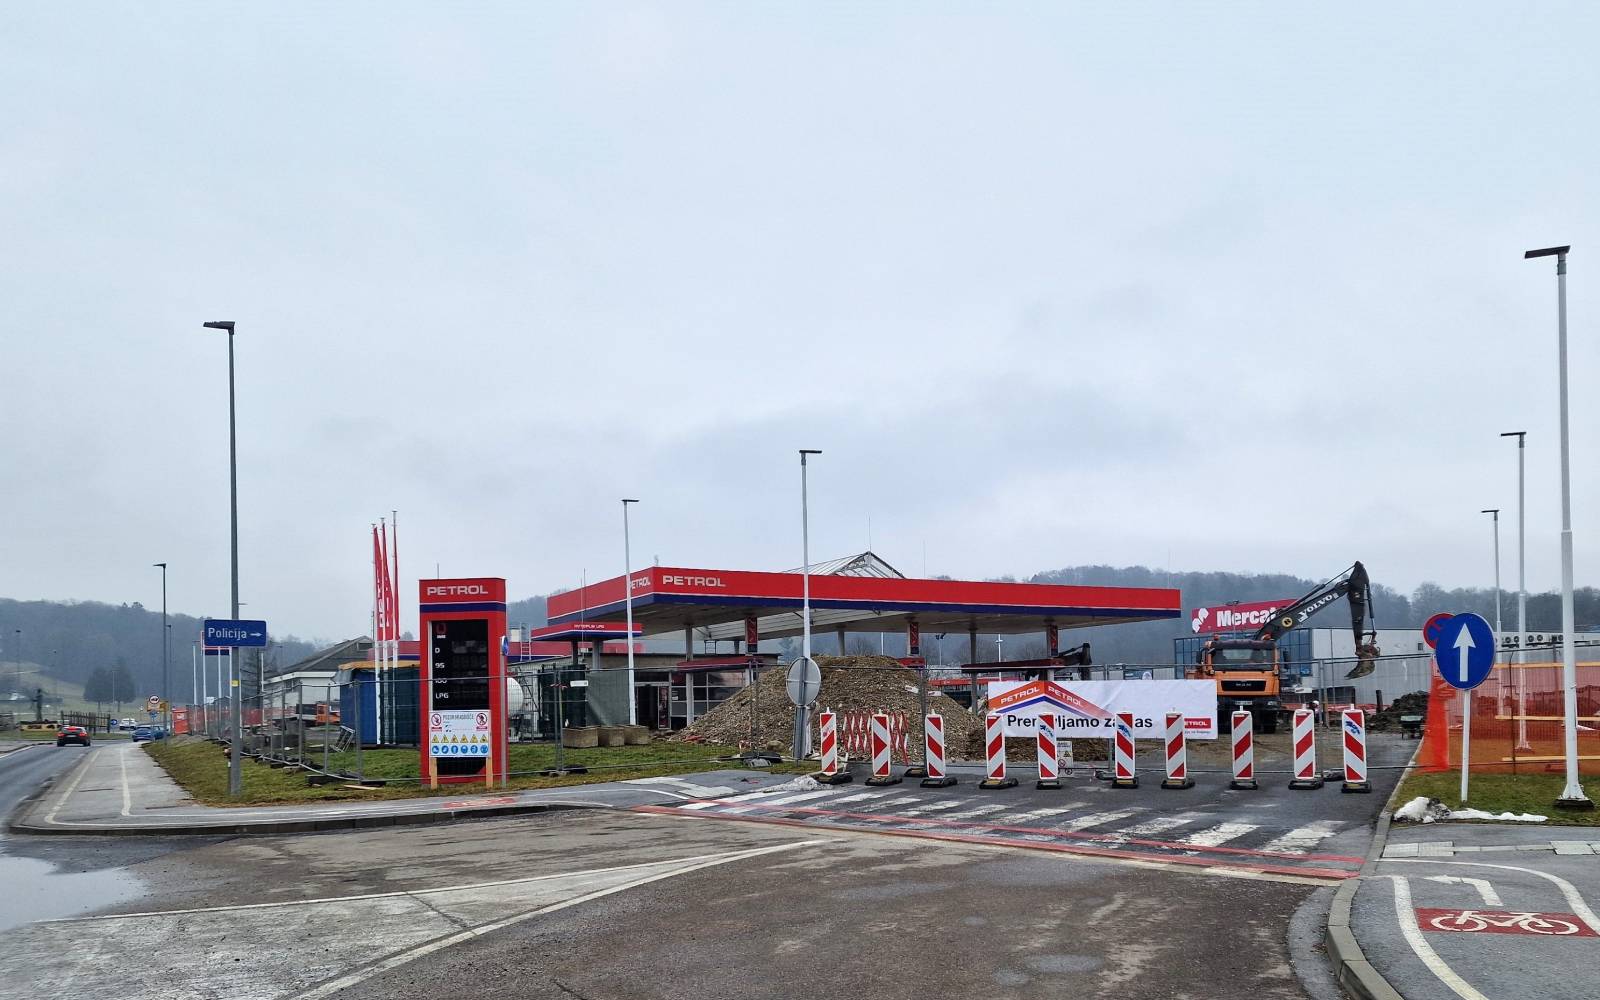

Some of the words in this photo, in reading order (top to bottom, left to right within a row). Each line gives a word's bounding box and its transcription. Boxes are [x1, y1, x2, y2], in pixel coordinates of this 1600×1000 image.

[427, 585, 488, 596] PETROL
[662, 575, 726, 587] PETROL
[1298, 594, 1333, 620] VOLVO
[1217, 607, 1277, 627] Mercat
[208, 627, 247, 641] Policija
[1000, 686, 1040, 705] PETROL
[1047, 685, 1083, 707] PETROL
